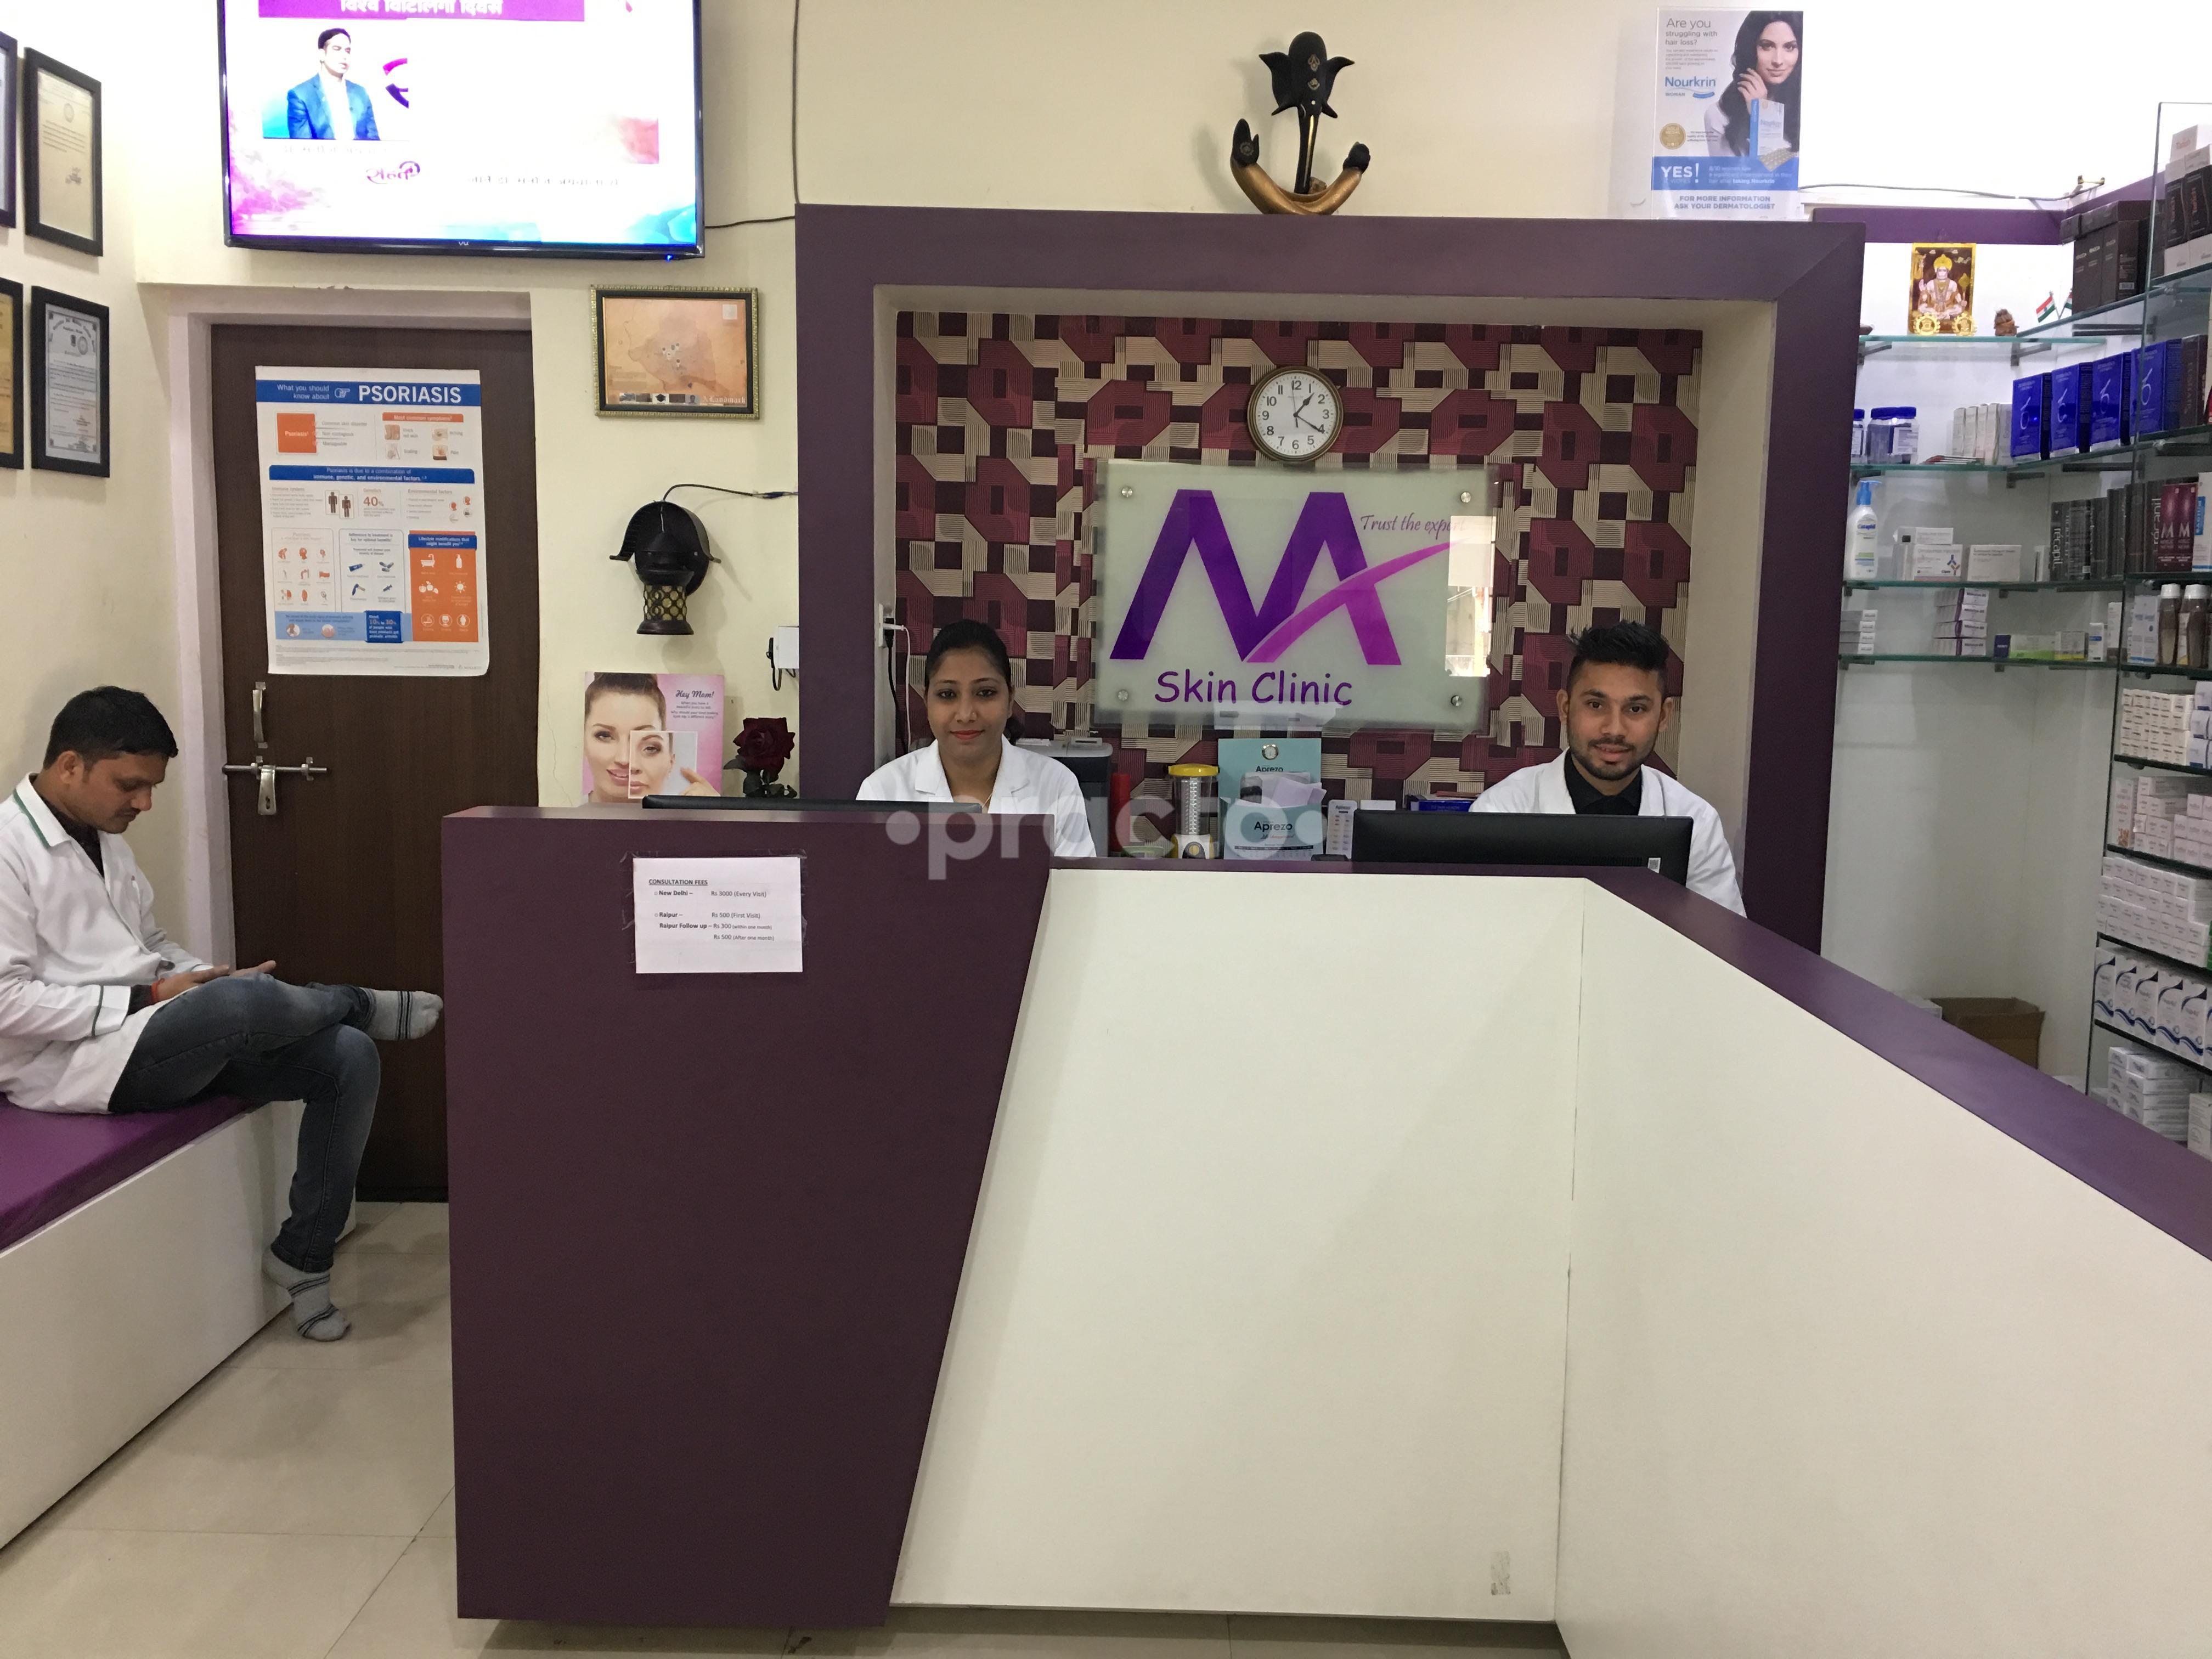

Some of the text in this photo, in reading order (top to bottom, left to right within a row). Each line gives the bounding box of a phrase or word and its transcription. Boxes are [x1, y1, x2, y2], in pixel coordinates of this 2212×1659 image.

[1666, 18, 1711, 30] Are you
[1665, 76, 1716, 87] Nourkrin
[1661, 163, 1700, 183] YES!
[1291, 380, 1301, 390] 12
[359, 385, 461, 403] PSORIASIS
[1318, 394, 1325, 404] 2
[1267, 396, 1277, 406] 10
[1262, 410, 1269, 420] 9
[1323, 409, 1330, 419] 3
[1267, 426, 1274, 436] 8
[1318, 424, 1325, 434] 4
[1278, 436, 1284, 446] 7
[1292, 439, 1299, 449] 6
[1307, 436, 1314, 445] 5
[1361, 514, 1398, 531] Trust
[1401, 512, 1421, 531] the
[1155, 668, 1353, 707] Skin Clinic
[675, 690, 714, 699] Hey Mom!
[1254, 821, 1293, 832] Aprezo
